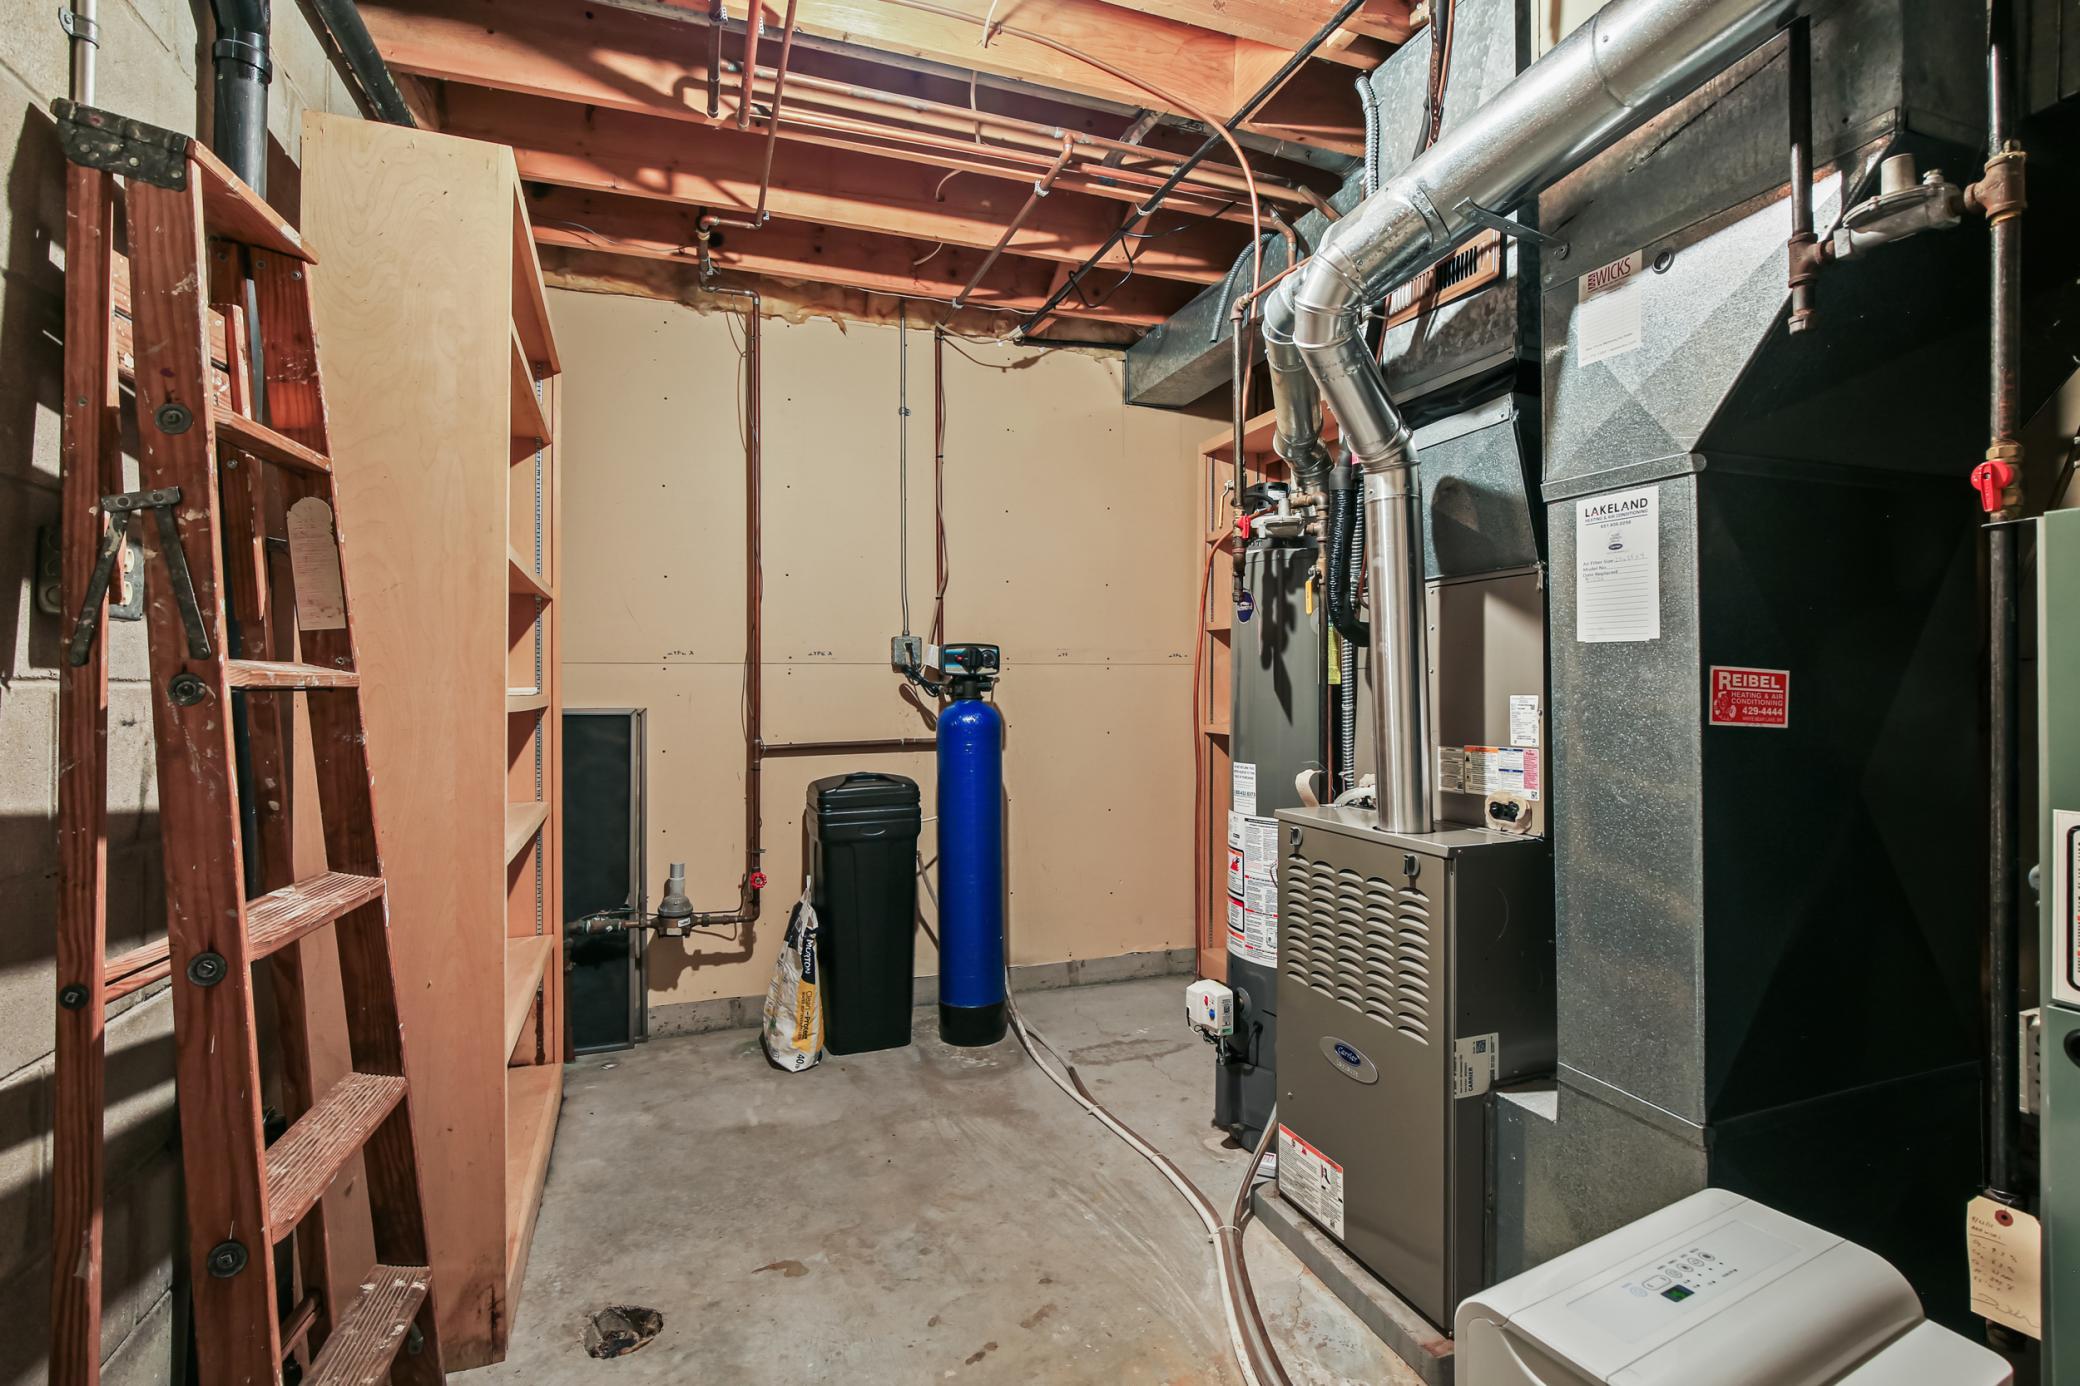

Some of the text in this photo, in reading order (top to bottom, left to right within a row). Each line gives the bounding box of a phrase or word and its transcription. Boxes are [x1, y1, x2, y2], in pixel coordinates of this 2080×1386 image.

[1595, 257, 1631, 286] WICKS
[1584, 498, 1648, 518] LAKELAND
[1718, 671, 1781, 690] REIBEL
[1731, 691, 1762, 699] HEATING
[1731, 698, 1783, 706] CONDITIONING
[1742, 706, 1783, 716] 429-4444
[803, 939, 813, 975] MORTON
[796, 1054, 805, 1065] 40
